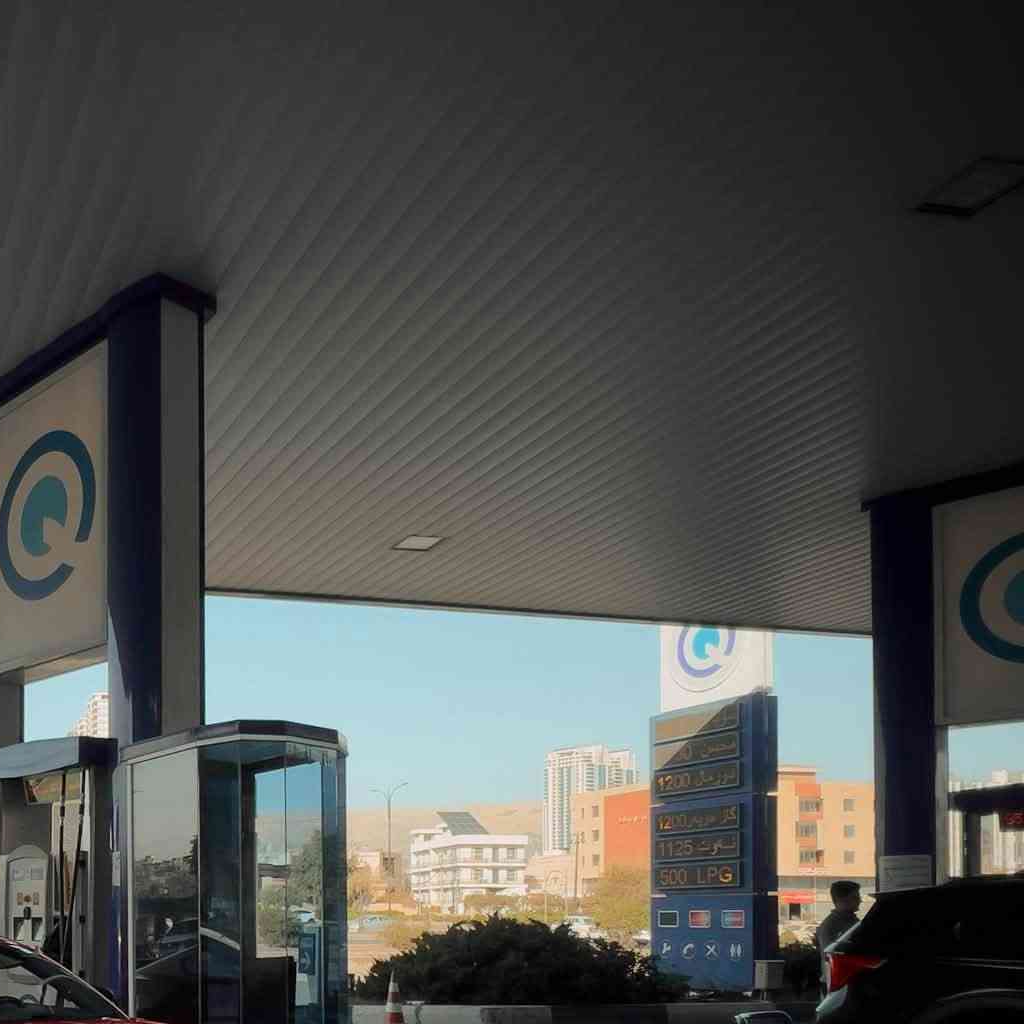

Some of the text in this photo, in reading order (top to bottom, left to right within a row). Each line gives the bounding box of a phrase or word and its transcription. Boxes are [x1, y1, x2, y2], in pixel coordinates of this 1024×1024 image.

[657, 840, 692, 857] 1125
[660, 864, 732, 886] 500 LPG
